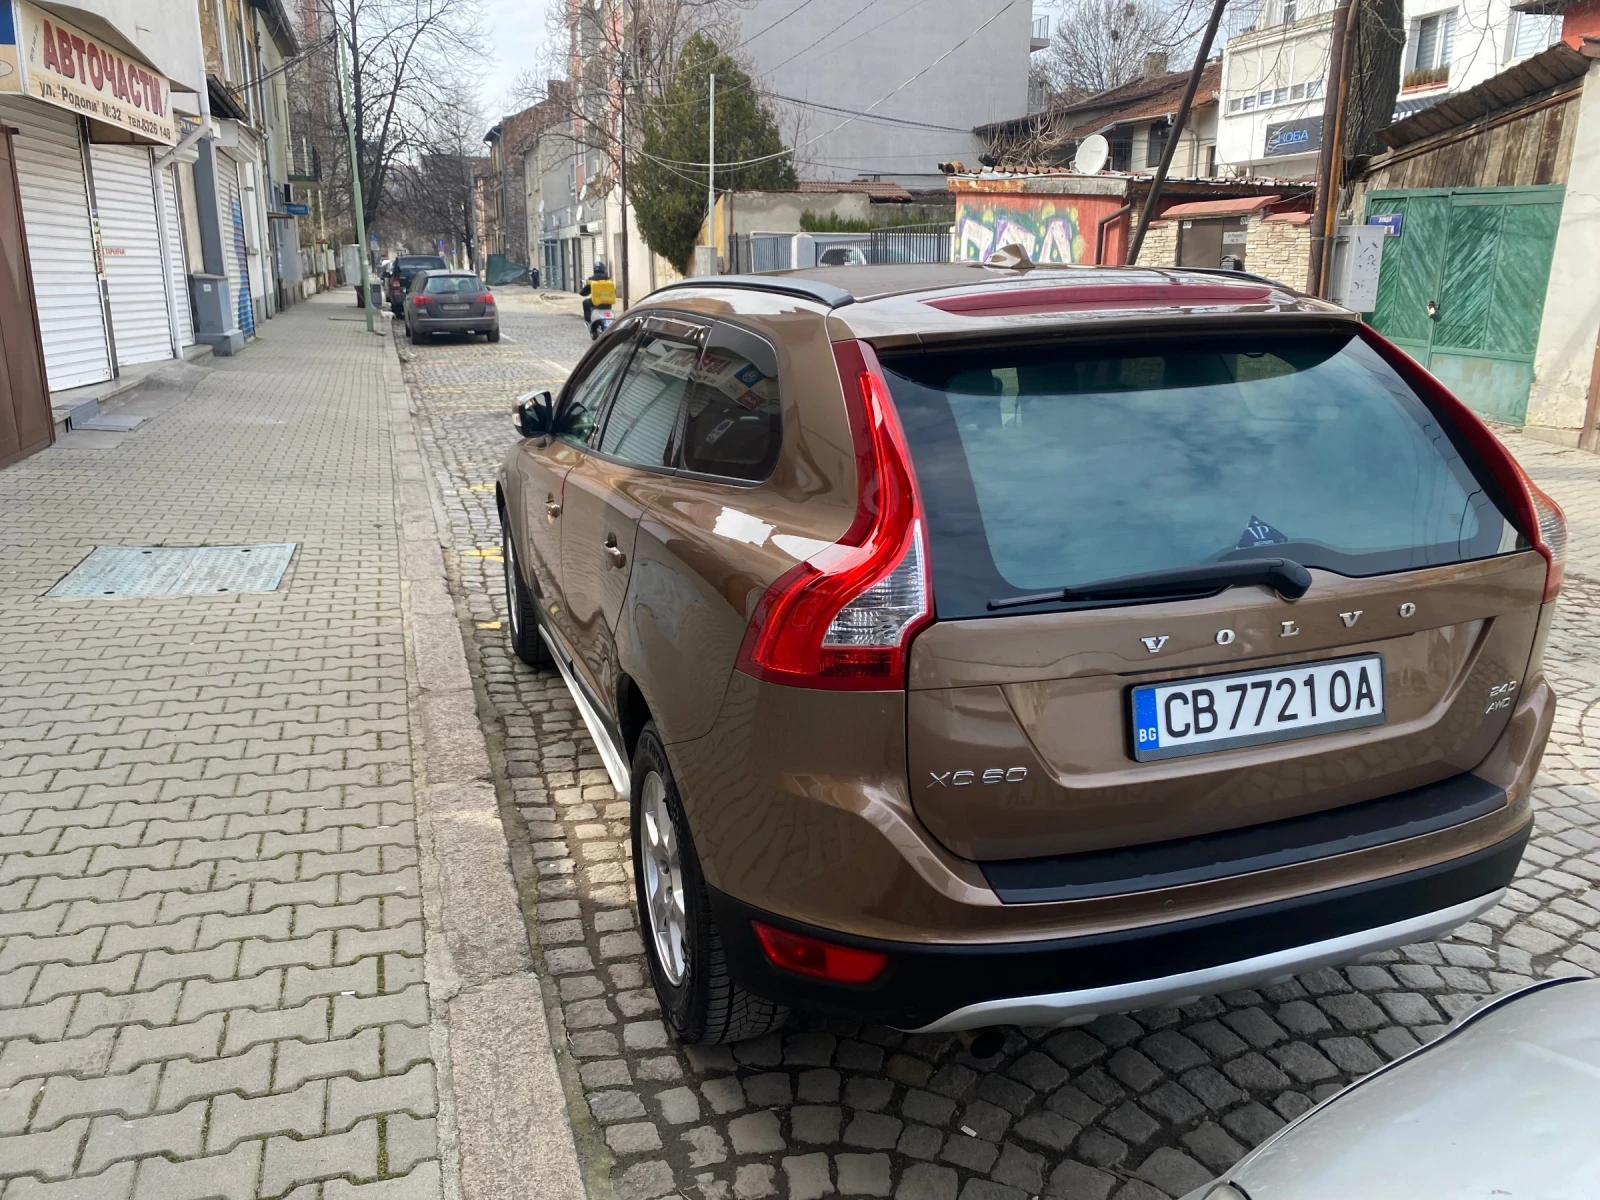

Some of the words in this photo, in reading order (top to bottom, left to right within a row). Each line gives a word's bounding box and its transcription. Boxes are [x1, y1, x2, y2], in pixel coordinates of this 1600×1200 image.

[43, 19, 163, 117] АВТОЧАСТИ
[39, 81, 56, 98] ул.
[159, 126, 171, 141] 148
[1141, 602, 1416, 653] VOLVO
[1139, 729, 1157, 742] BG
